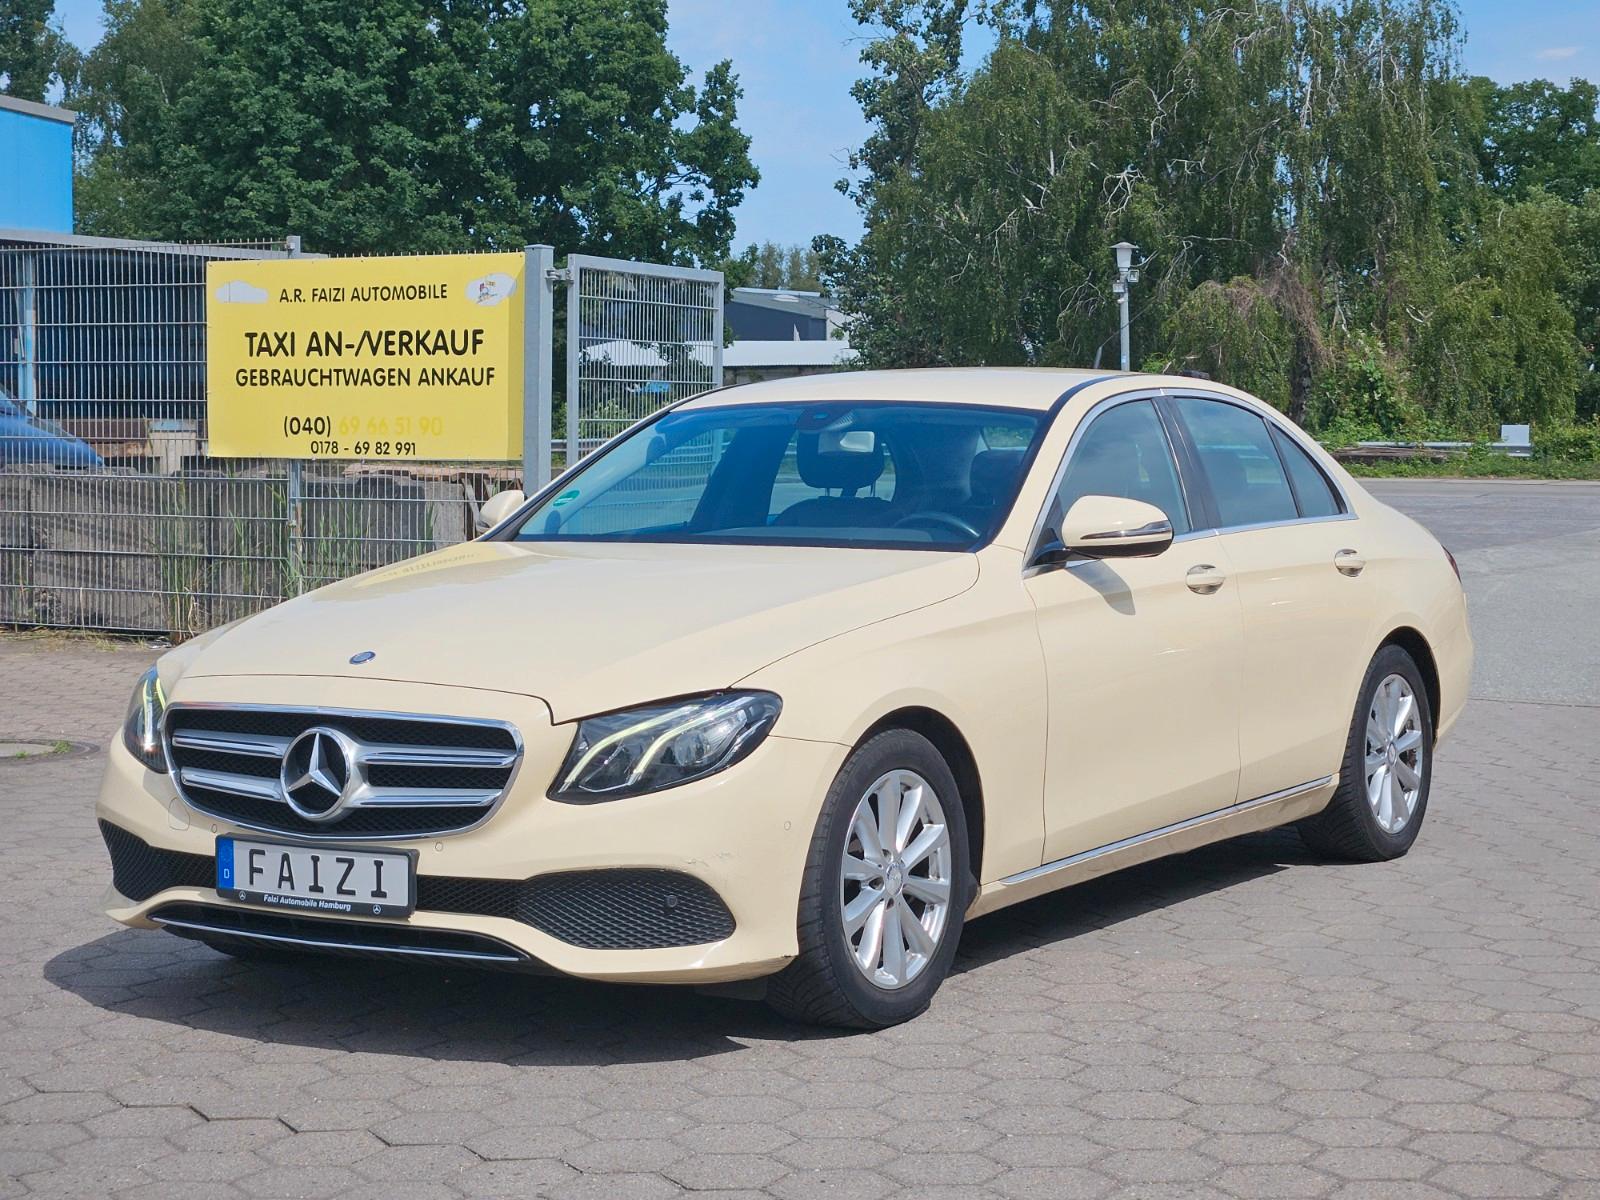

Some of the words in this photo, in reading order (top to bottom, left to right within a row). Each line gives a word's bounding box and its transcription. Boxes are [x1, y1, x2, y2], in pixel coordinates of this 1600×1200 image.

[279, 288, 306, 303] A.R.
[311, 287, 346, 303] FAIZI
[350, 283, 448, 302] AUTOMOBILE
[244, 331, 296, 357] TAXI
[235, 367, 411, 387] GEBRAUCHTWAGEN
[417, 366, 496, 386] ANKAUF
[283, 415, 332, 437] (040)
[310, 440, 339, 455] 0178
[354, 440, 371, 455] 69
[375, 441, 391, 455] 82
[395, 442, 416, 456] 991
[223, 868, 230, 879] D
[248, 848, 388, 899] FAIZI
[280, 896, 318, 908] Automobile
[319, 900, 352, 912] Hamburg
